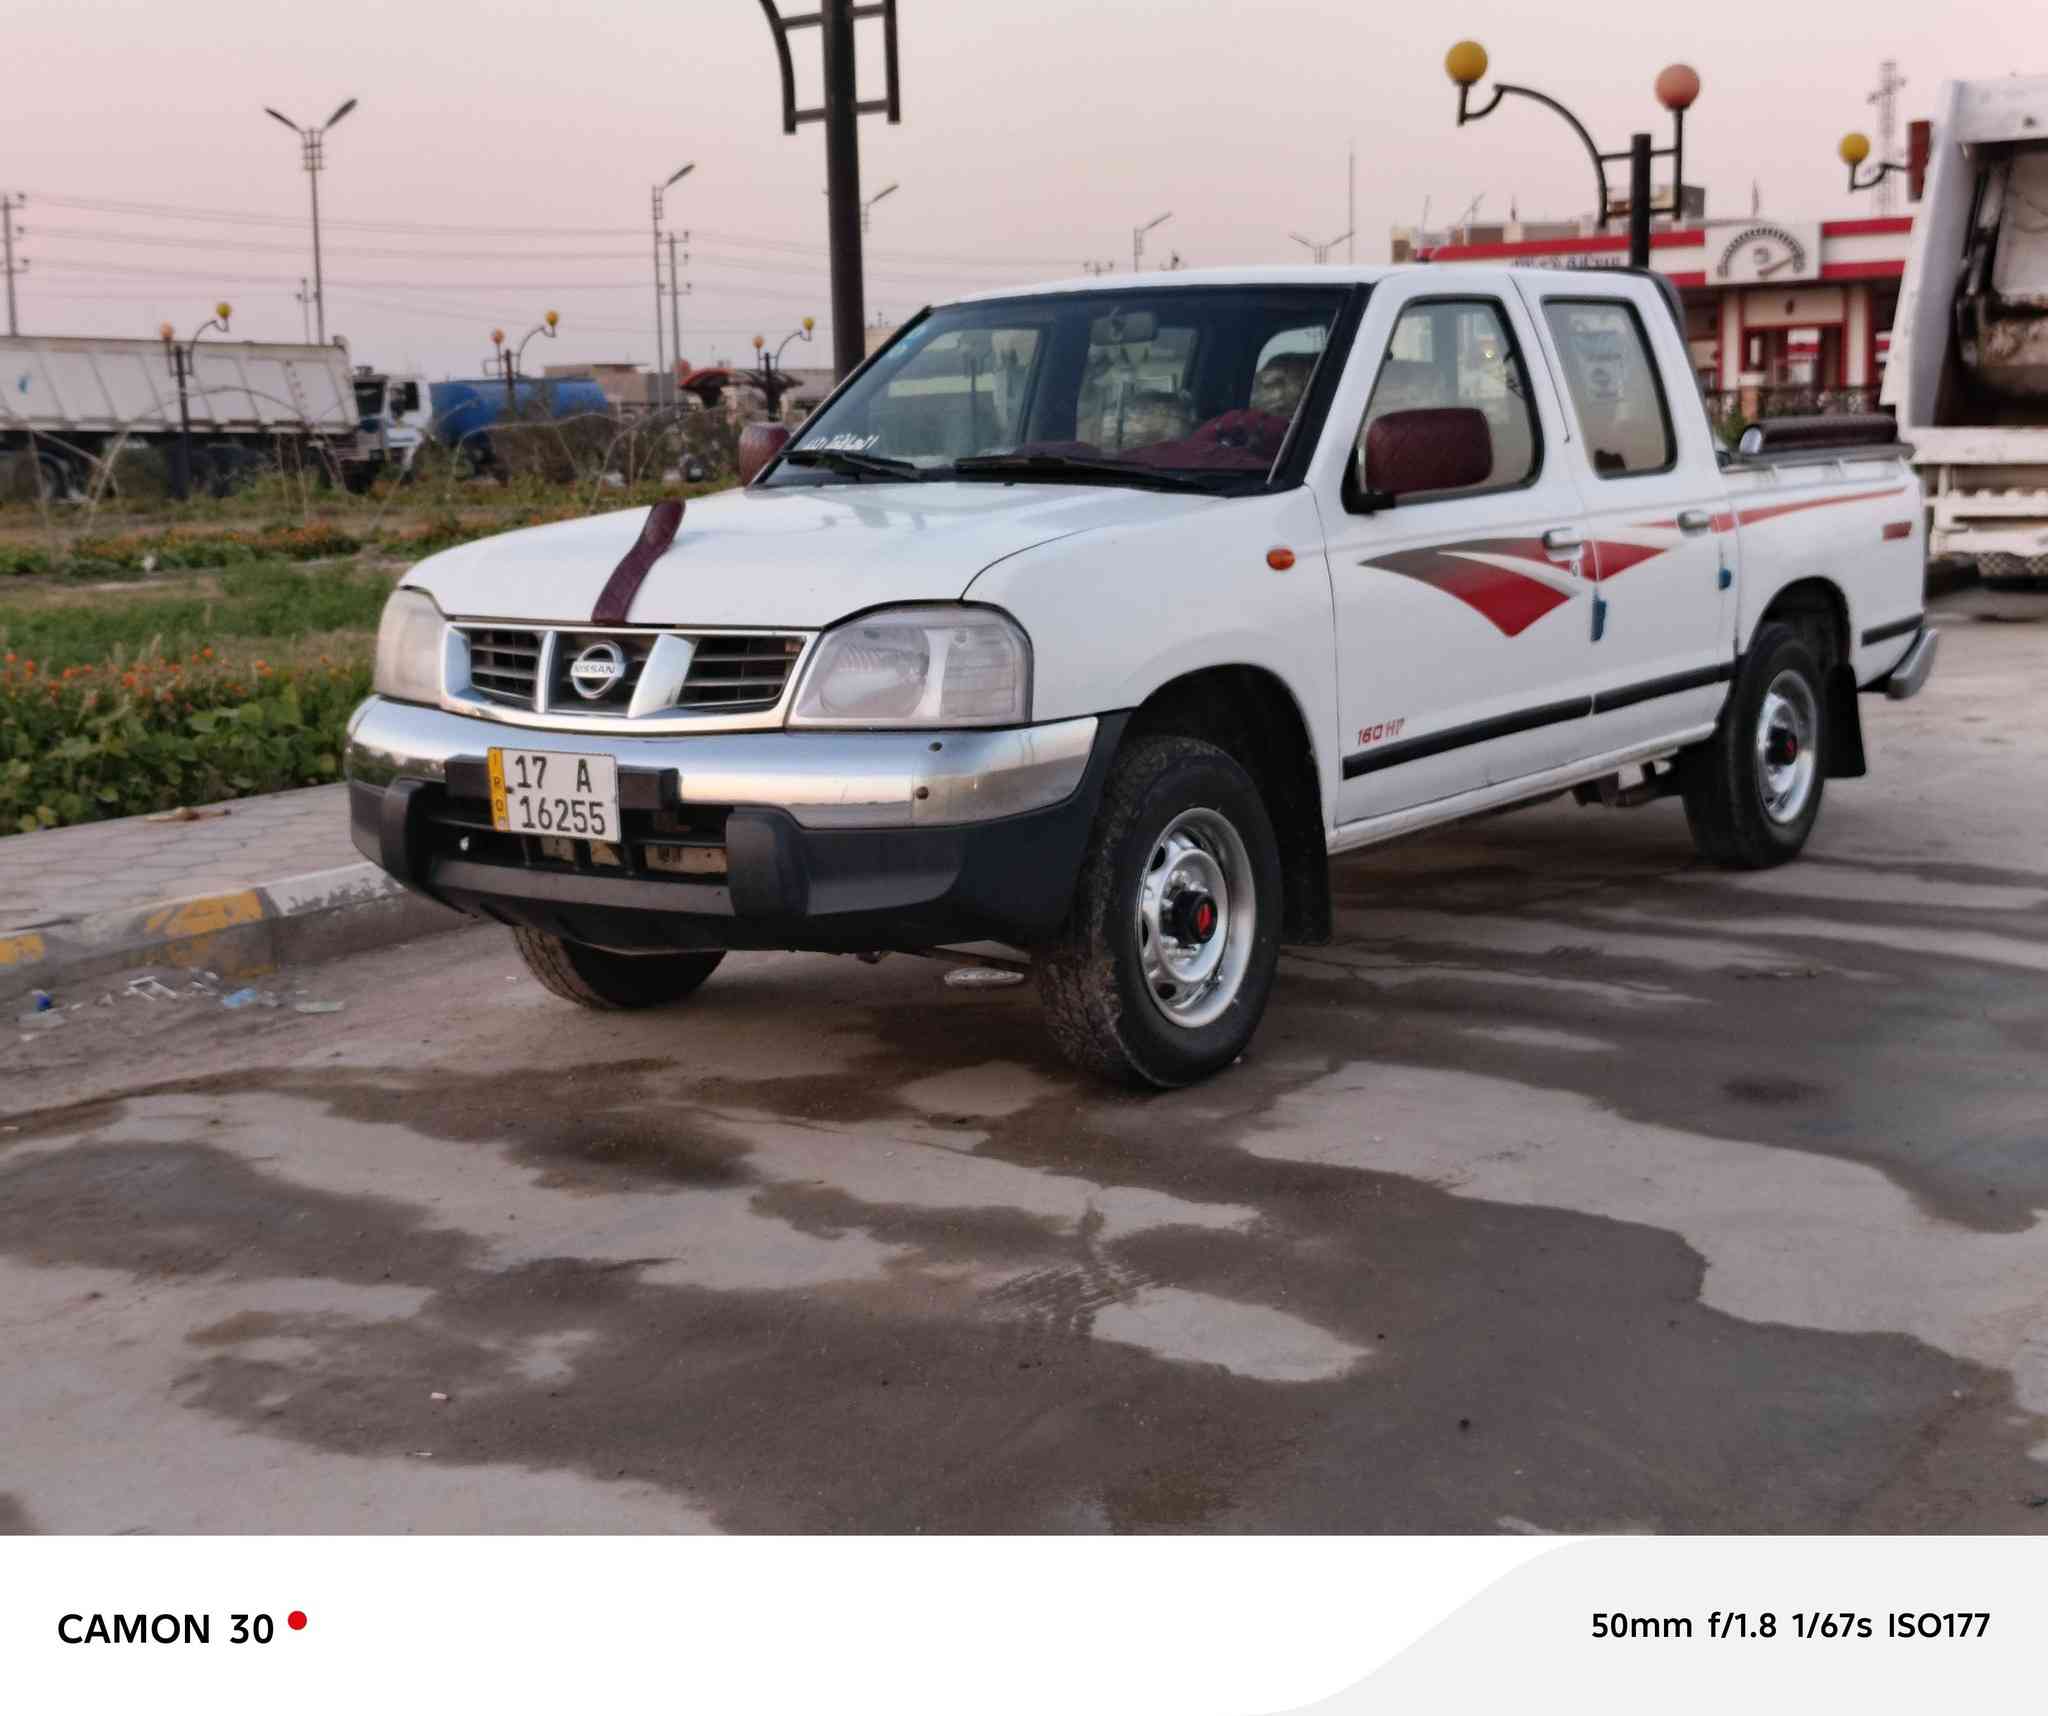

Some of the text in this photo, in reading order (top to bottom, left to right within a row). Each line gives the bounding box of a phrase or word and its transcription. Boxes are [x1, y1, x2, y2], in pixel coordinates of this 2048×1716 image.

[574, 663, 616, 674] NISSAN
[1357, 725, 1383, 746] 160
[514, 754, 593, 793] 17 A
[519, 795, 606, 835] 16255
